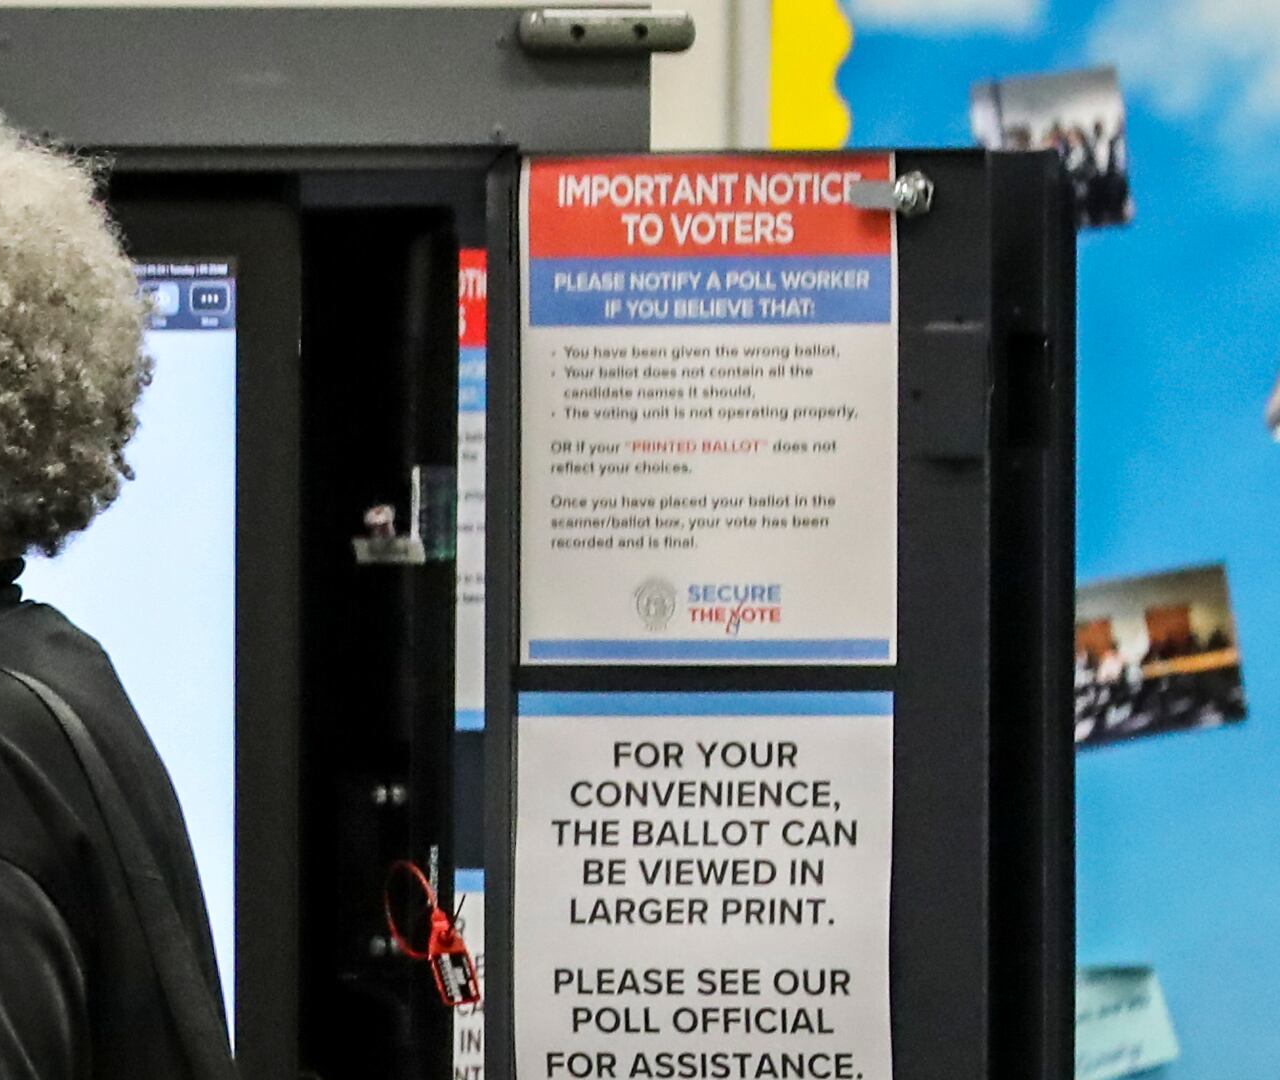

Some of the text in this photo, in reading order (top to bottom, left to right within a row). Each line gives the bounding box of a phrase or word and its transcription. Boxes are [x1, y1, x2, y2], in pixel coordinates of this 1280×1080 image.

[558, 173, 738, 208] IMPORTANT
[621, 213, 794, 246] TO VOTERS
[554, 270, 869, 292] PLEASE NOTIFY A POLL WORKER
[605, 298, 815, 318] IF YOU BELIEVE THAT:
[564, 346, 589, 359] You
[594, 346, 627, 358] have
[632, 346, 667, 358] been
[672, 346, 710, 361] given
[716, 345, 738, 357] the
[743, 347, 789, 360] wrong
[565, 365, 813, 379] Your ballot does not contain all the
[564, 387, 633, 400] candidate
[638, 389, 683, 399] names
[689, 387, 696, 399] it
[565, 407, 589, 420] The
[594, 407, 638, 423] voting
[643, 407, 669, 419] unit
[674, 407, 685, 419] is
[690, 408, 713, 419] not
[718, 406, 788, 423] operating
[551, 441, 572, 454] OR
[576, 441, 585, 454] if
[589, 444, 620, 456] your
[773, 440, 808, 452] does
[813, 441, 837, 452] not
[551, 462, 692, 476] reflect your choices.
[551, 495, 835, 511] Once you have placed your ballot in the
[551, 516, 650, 530] scanner/ballot
[688, 518, 720, 530] your
[726, 518, 757, 528] vote
[761, 516, 787, 528] has
[792, 515, 828, 528] been
[551, 536, 698, 549] recorded and is final.
[688, 584, 781, 602] SECURE
[689, 607, 725, 623] THE
[613, 742, 798, 769] FOR YOUR
[570, 781, 840, 811] CONVENIENCE,
[552, 820, 858, 847] THE BALLOT CAN
[583, 859, 824, 886] BE VIEWED IN
[570, 898, 835, 925] LARGER PRINT.
[554, 969, 851, 995] PLEASE SEE OUR
[573, 1007, 834, 1034] POLL OFFICIAL
[461, 1030, 481, 1053] IN
[546, 1052, 863, 1079] FOR ASSISTANCE.
